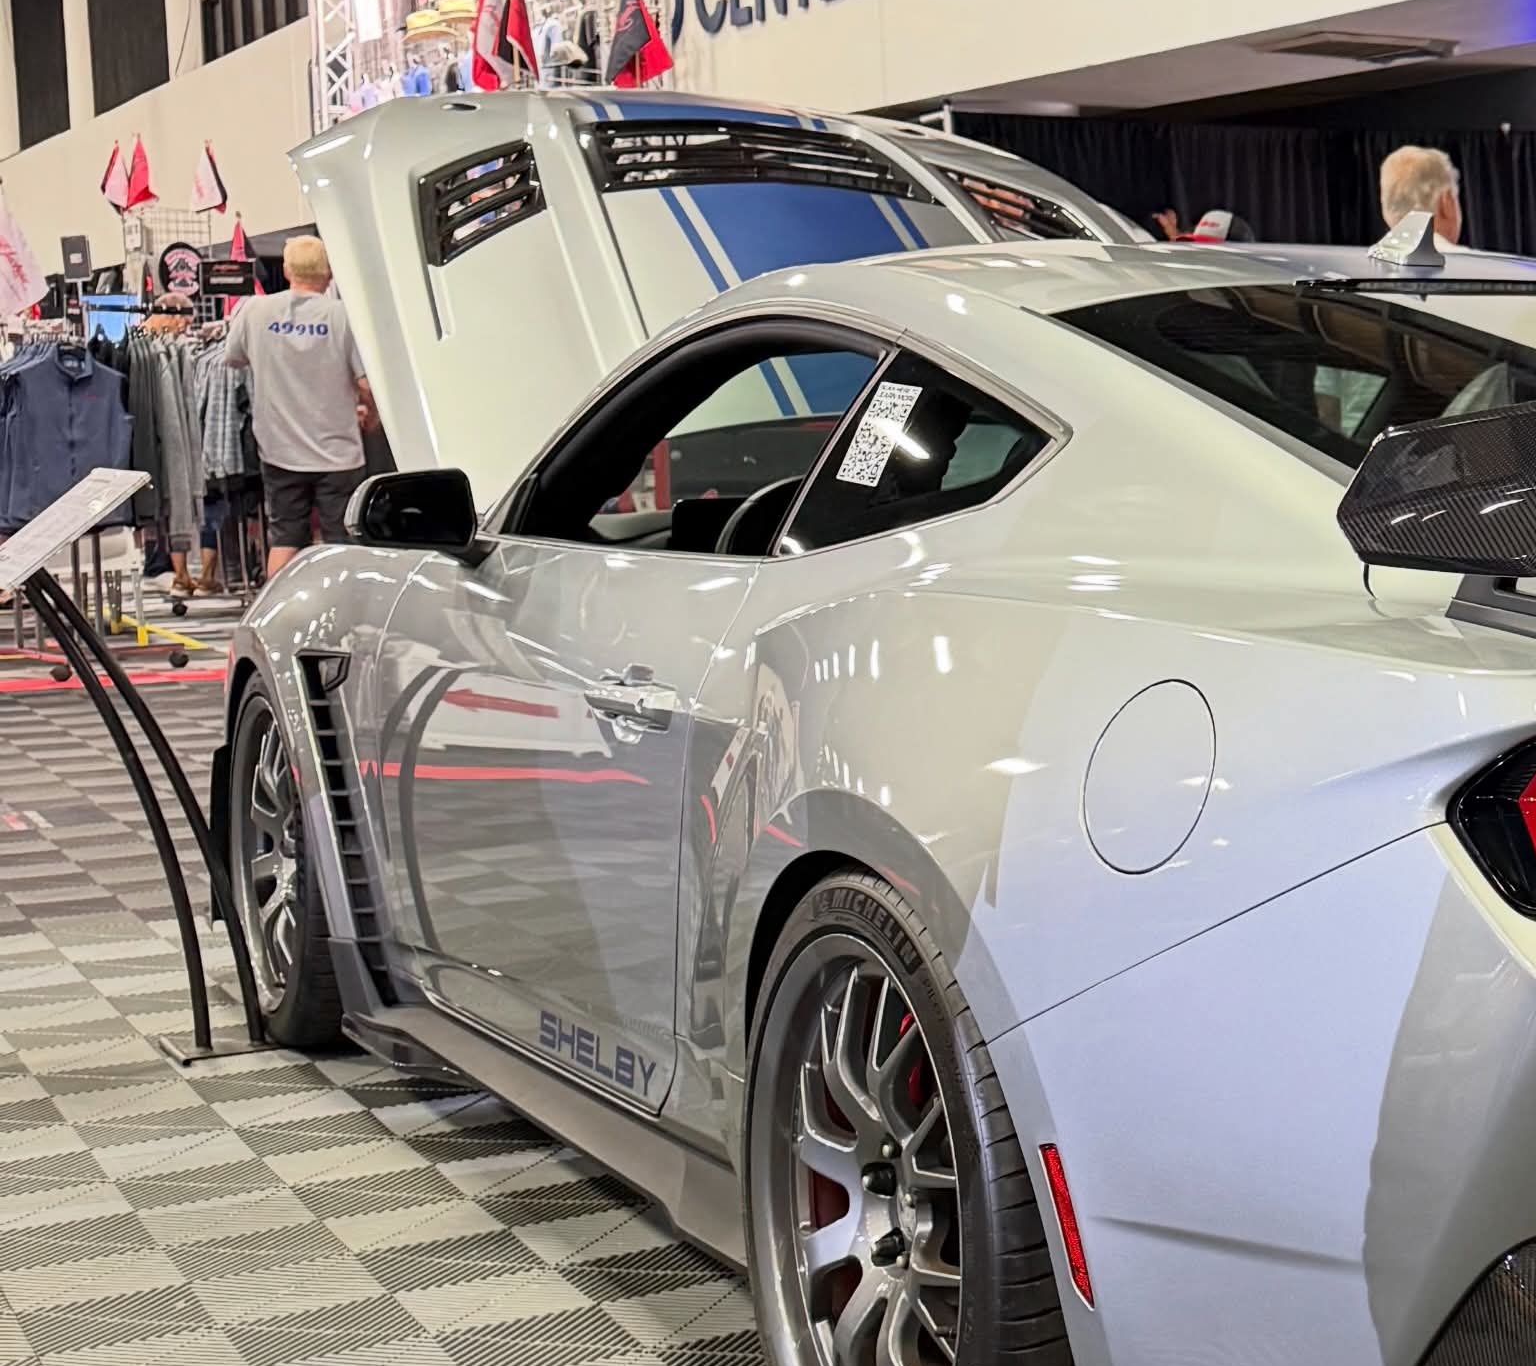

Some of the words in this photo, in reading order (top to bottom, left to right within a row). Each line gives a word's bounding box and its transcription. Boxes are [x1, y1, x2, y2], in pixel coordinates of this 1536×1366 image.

[268, 321, 328, 335] 49910
[831, 888, 919, 966] MICHELIN
[540, 1010, 656, 1096] SHELBY
